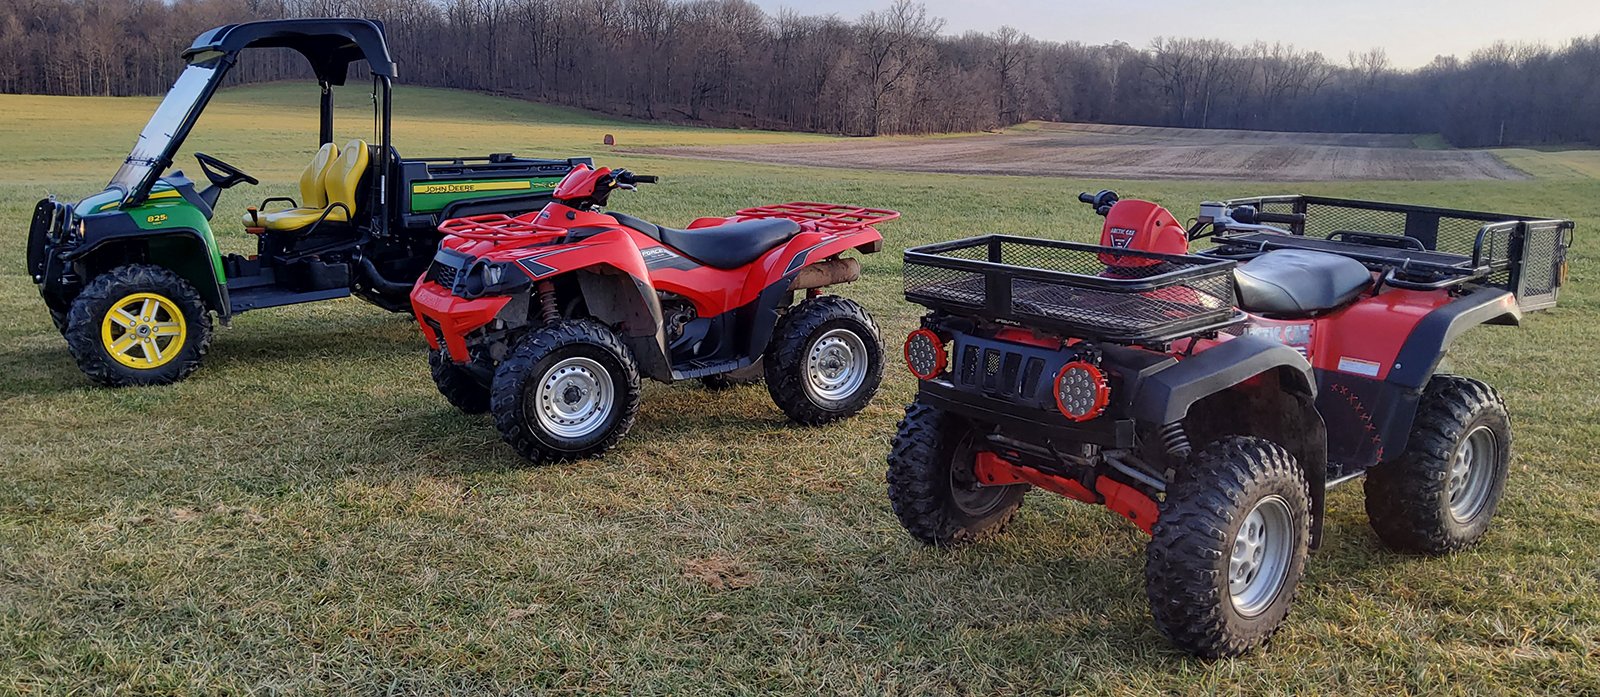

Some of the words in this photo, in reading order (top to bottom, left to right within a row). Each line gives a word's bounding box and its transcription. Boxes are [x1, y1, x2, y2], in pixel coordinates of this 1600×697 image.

[425, 185, 447, 193] JOHN
[448, 184, 475, 192] DEERE
[1284, 325, 1310, 344] CAT
